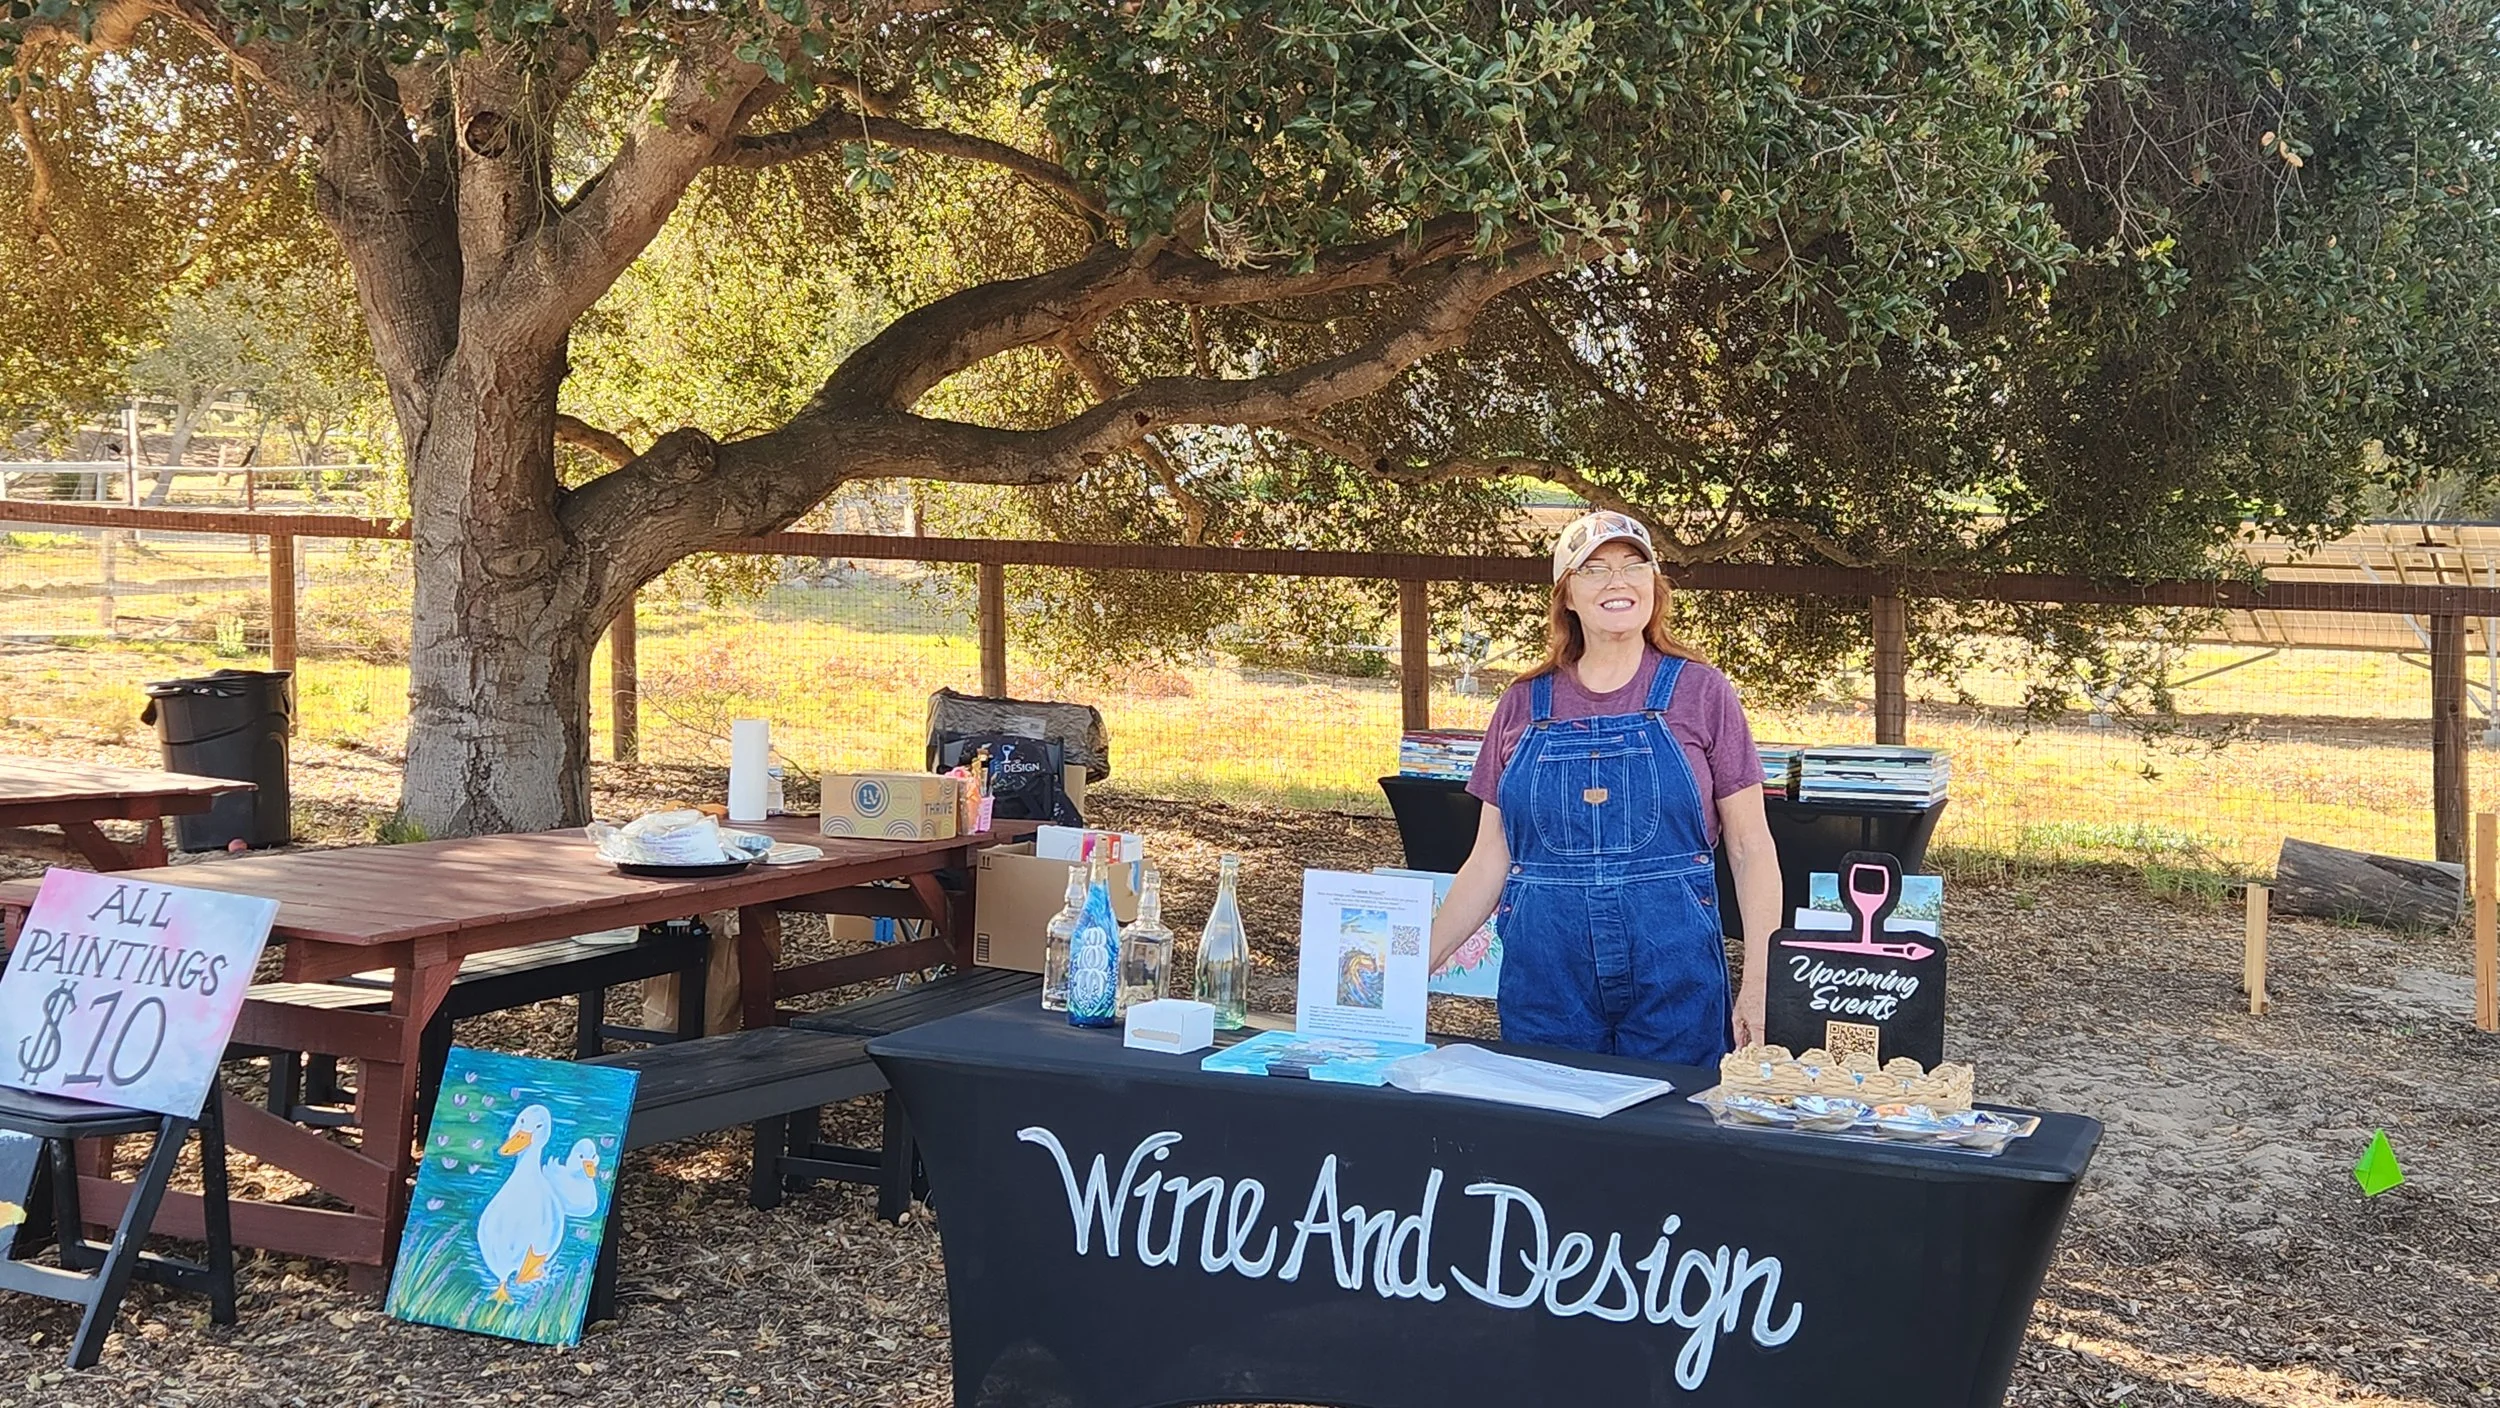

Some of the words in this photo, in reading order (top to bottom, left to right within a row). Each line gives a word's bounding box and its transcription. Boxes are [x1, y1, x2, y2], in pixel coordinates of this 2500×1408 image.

[1003, 762, 1040, 773] DESIGN
[924, 801, 953, 816] THRIVE
[88, 884, 173, 930] ALL
[18, 928, 228, 996] PAINTINGS
[1788, 955, 1920, 1000] Upcoming
[1809, 985, 1898, 1021] Events
[17, 979, 167, 1088] $10
[1016, 1126, 1278, 1279] Wine
[1278, 1153, 1447, 1302] And
[1450, 1182, 1803, 1392] Design
